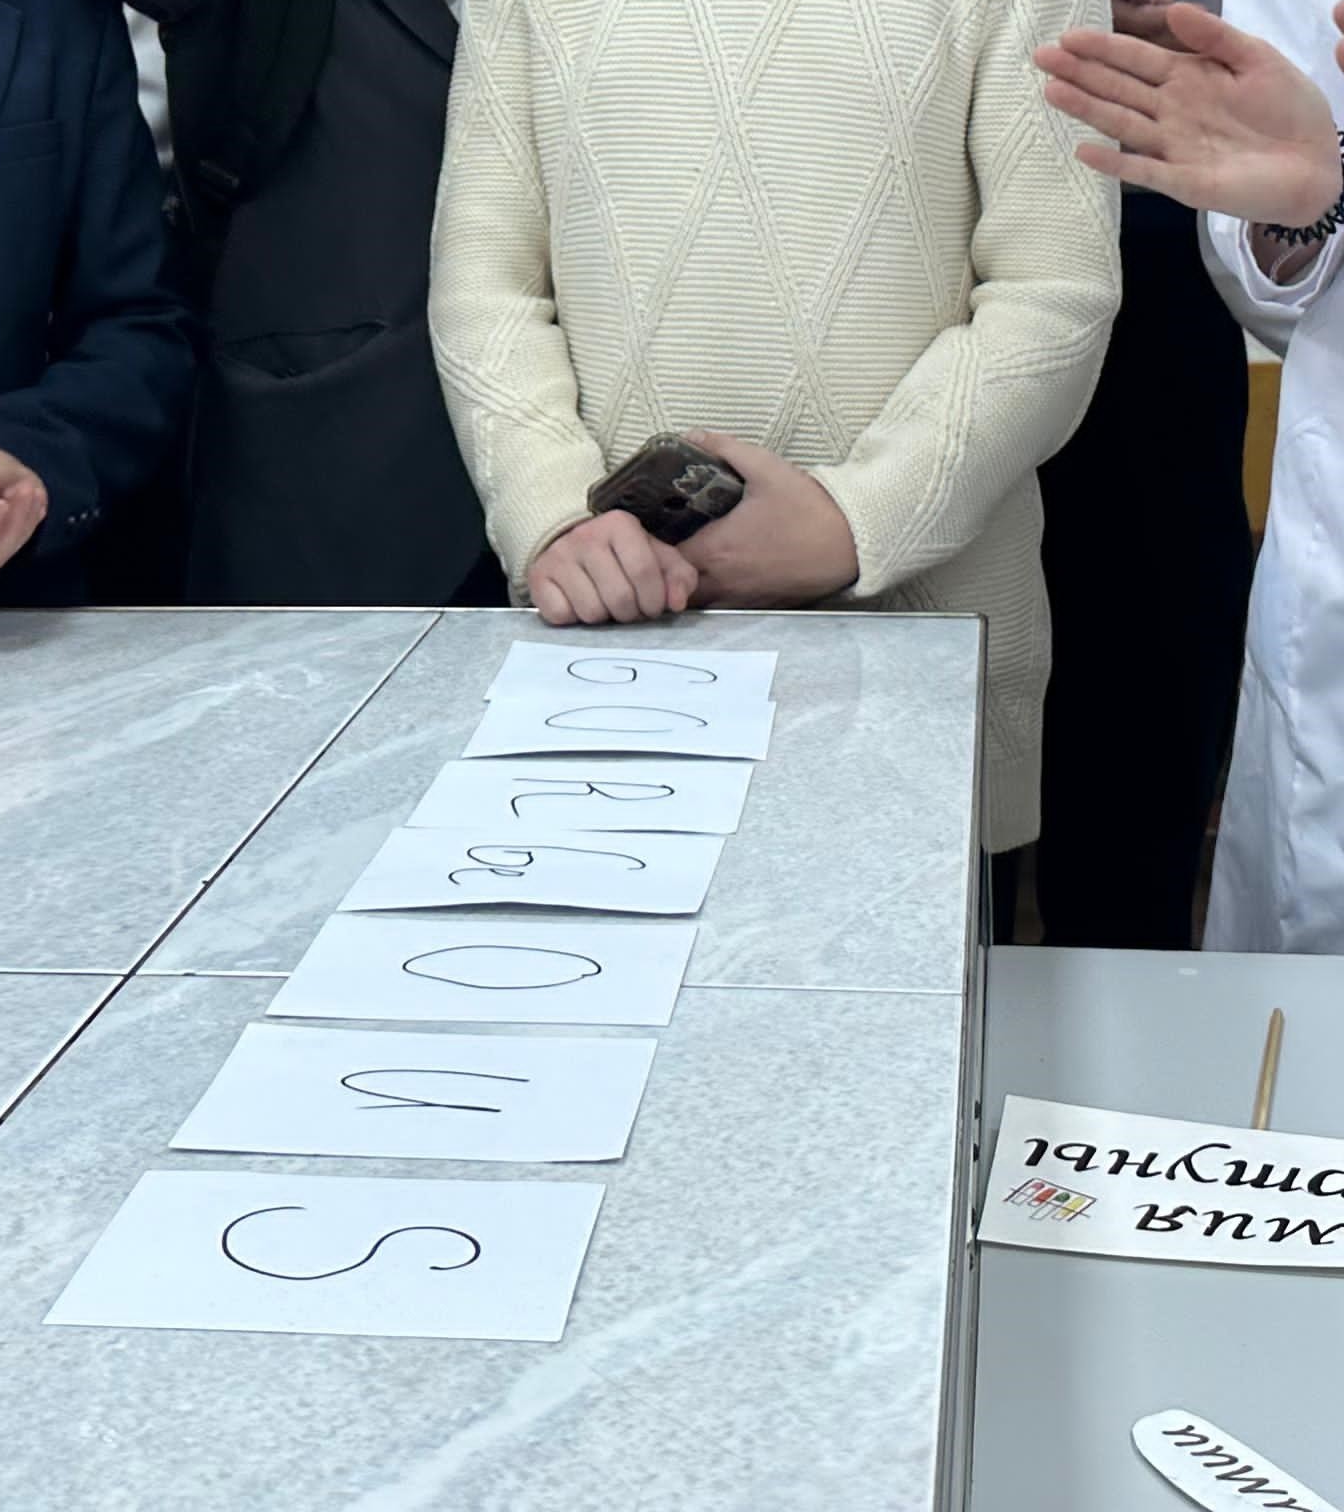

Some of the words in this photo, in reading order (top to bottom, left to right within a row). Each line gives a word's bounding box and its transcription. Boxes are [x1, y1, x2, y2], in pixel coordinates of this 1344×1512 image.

[510, 776, 676, 819] R
[401, 944, 603, 990] O
[221, 1205, 482, 1282] S
